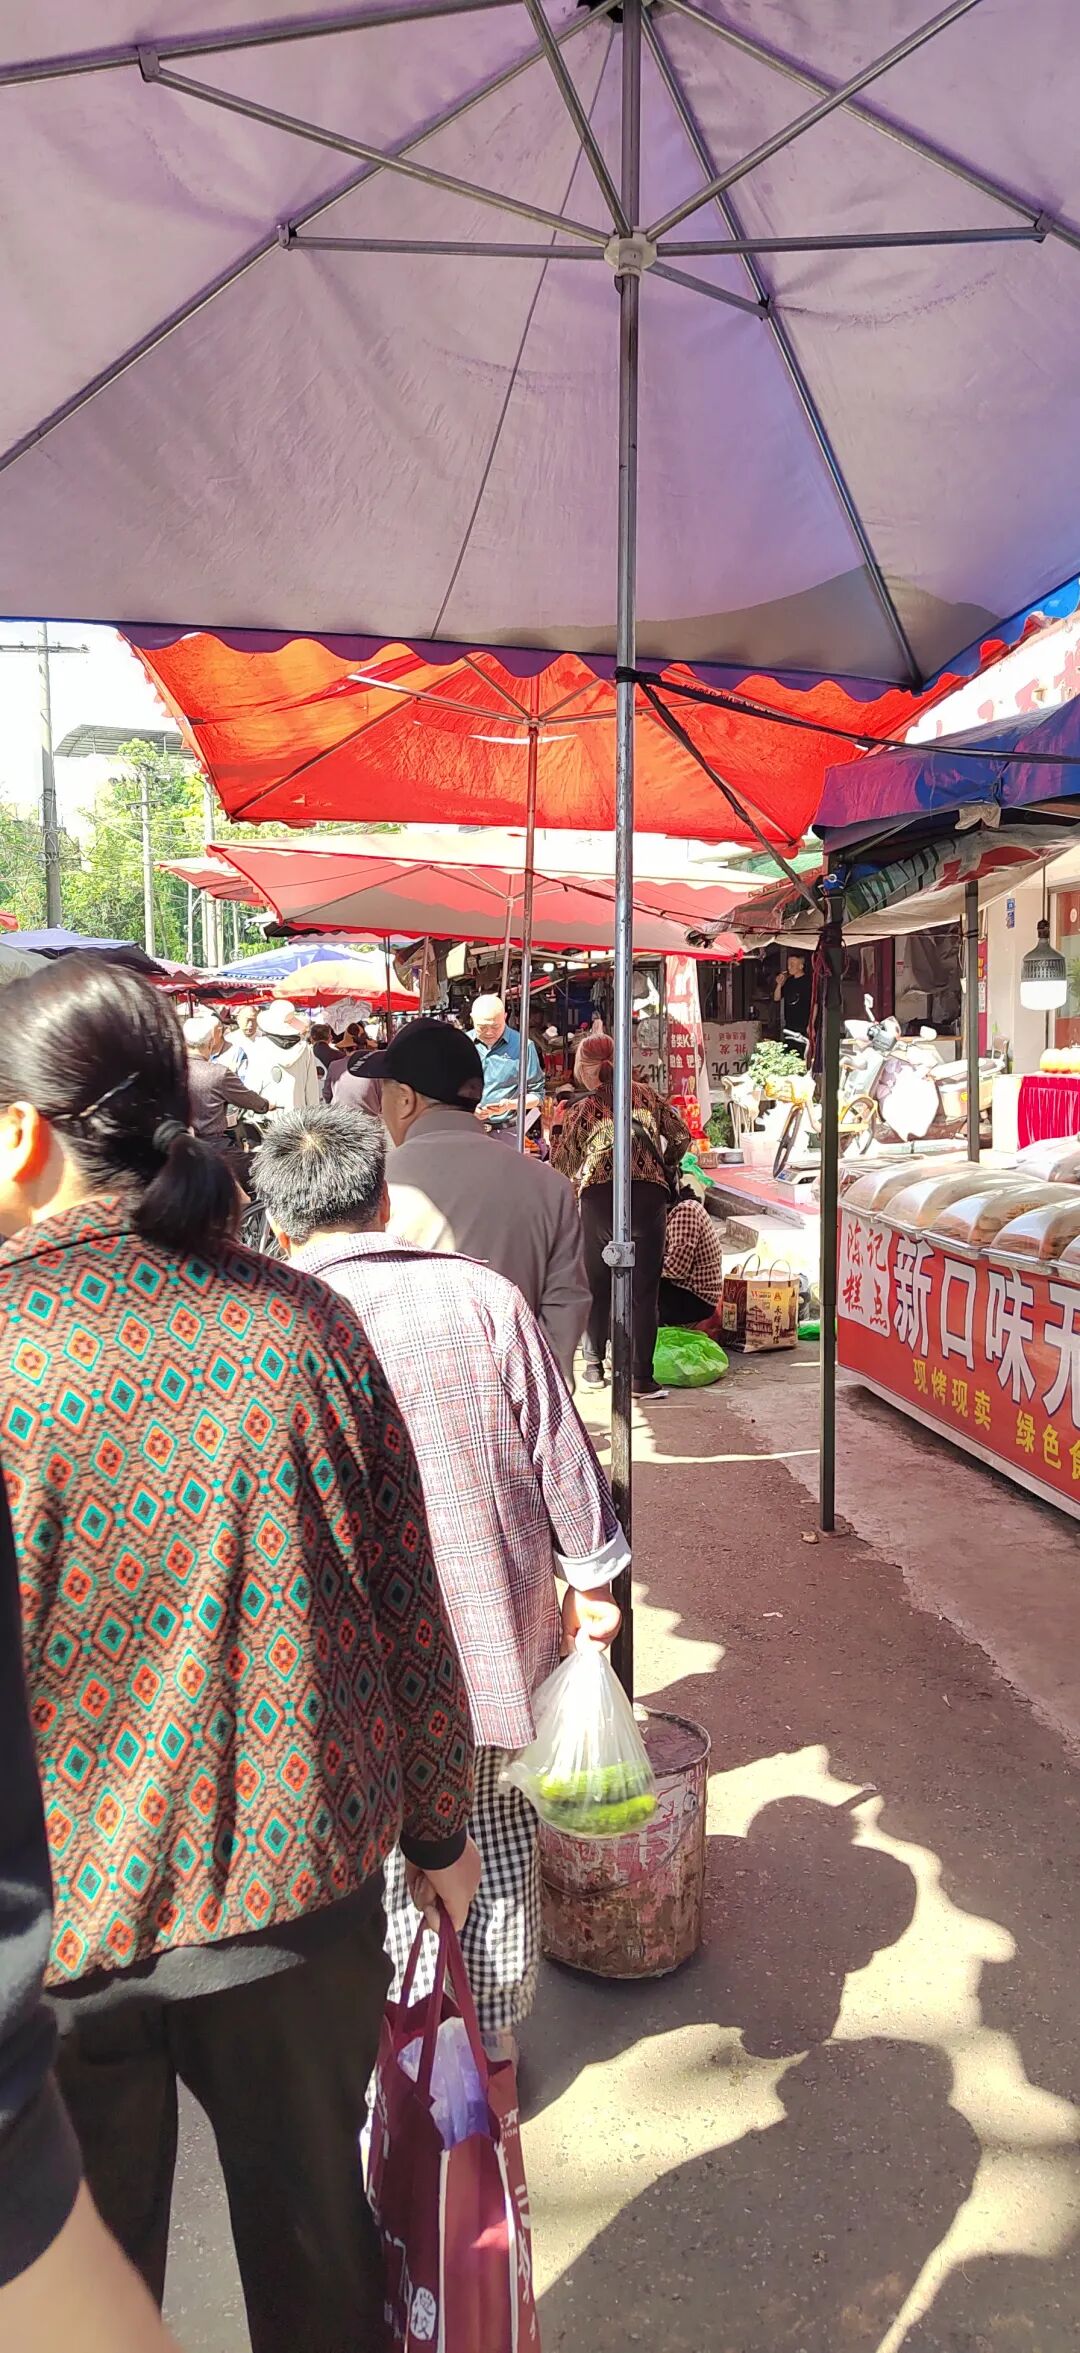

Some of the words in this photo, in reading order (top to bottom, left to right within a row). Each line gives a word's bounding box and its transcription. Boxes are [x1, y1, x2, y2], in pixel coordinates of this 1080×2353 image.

[848, 1222, 888, 1272] 陈记
[842, 1273, 888, 1330] 糕点
[913, 1359, 993, 1430] 现烤现卖
